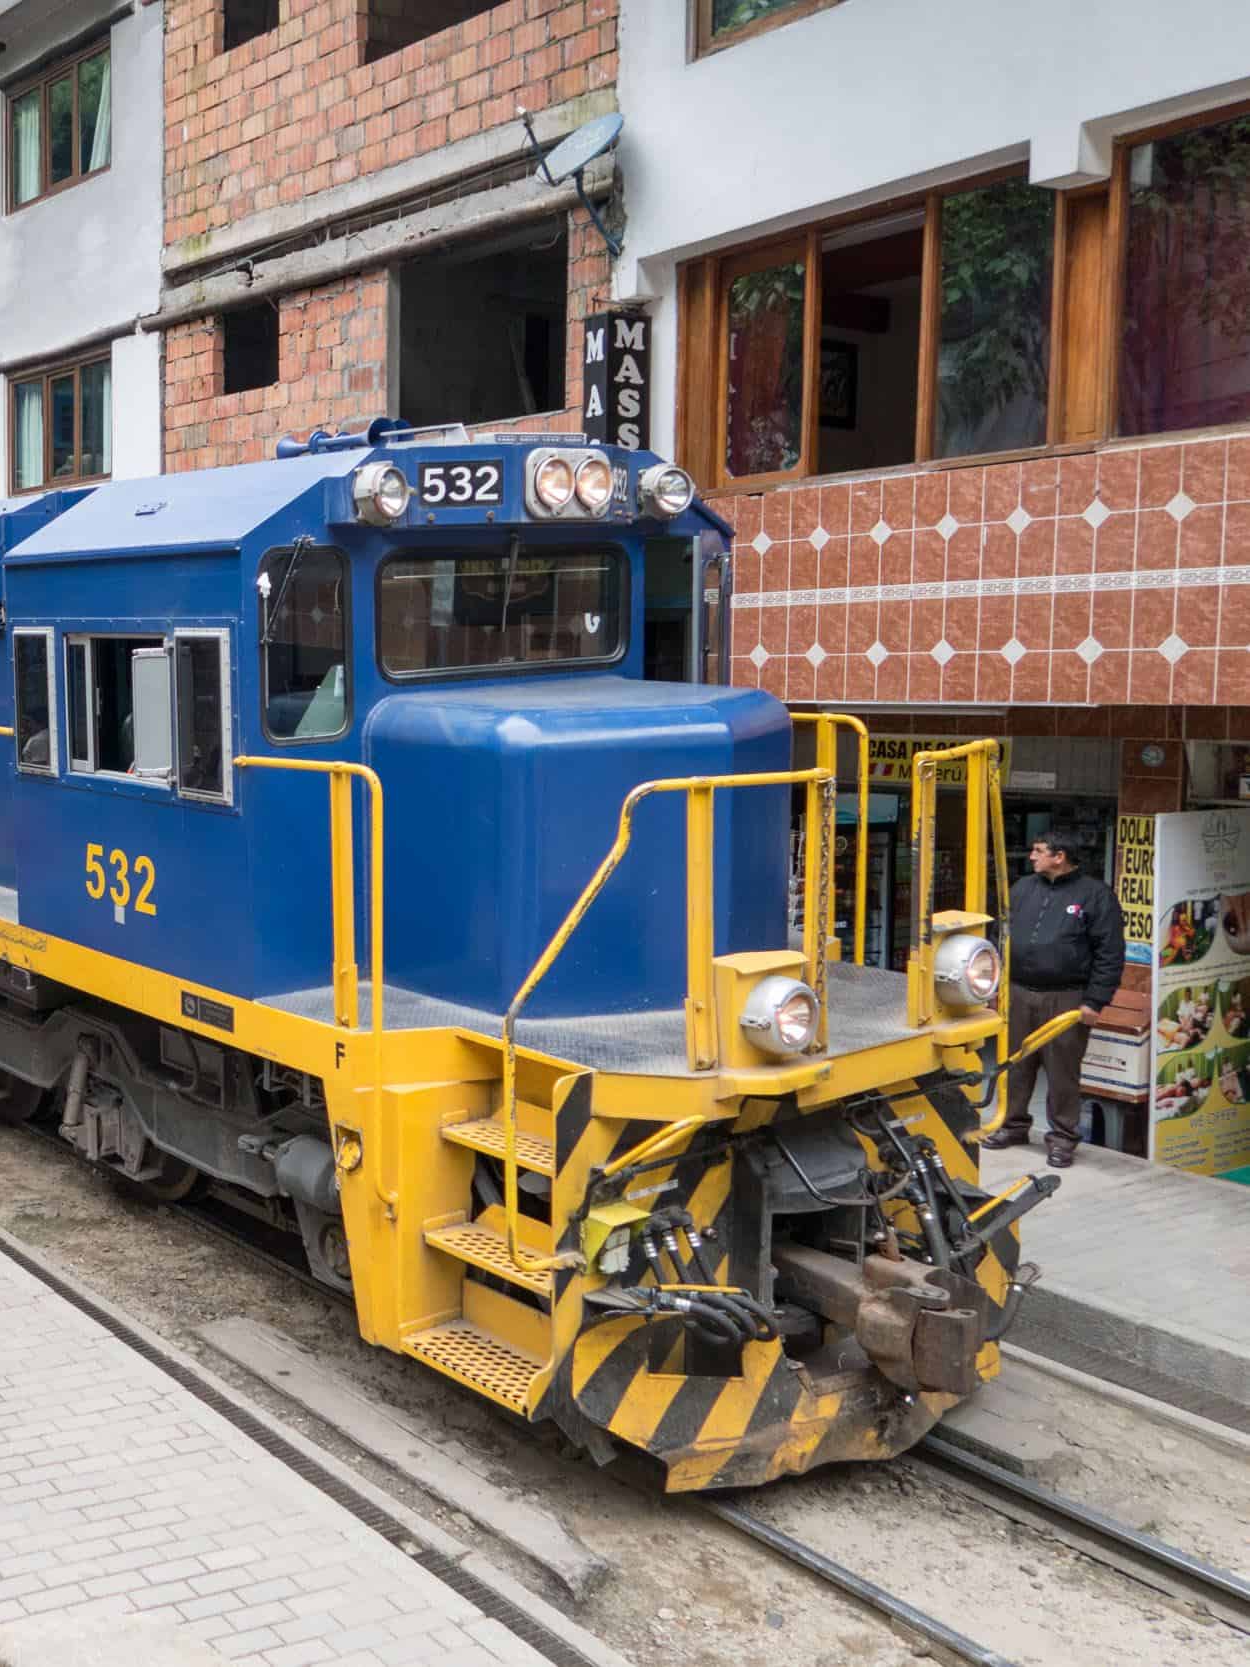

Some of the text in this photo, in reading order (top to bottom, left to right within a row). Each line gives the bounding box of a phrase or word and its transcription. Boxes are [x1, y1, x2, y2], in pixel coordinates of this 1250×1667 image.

[586, 328, 604, 445] MA
[422, 466, 499, 502] 532
[1120, 817, 1154, 846] DOLA
[86, 842, 157, 916] 532
[335, 1041, 346, 1069] F
